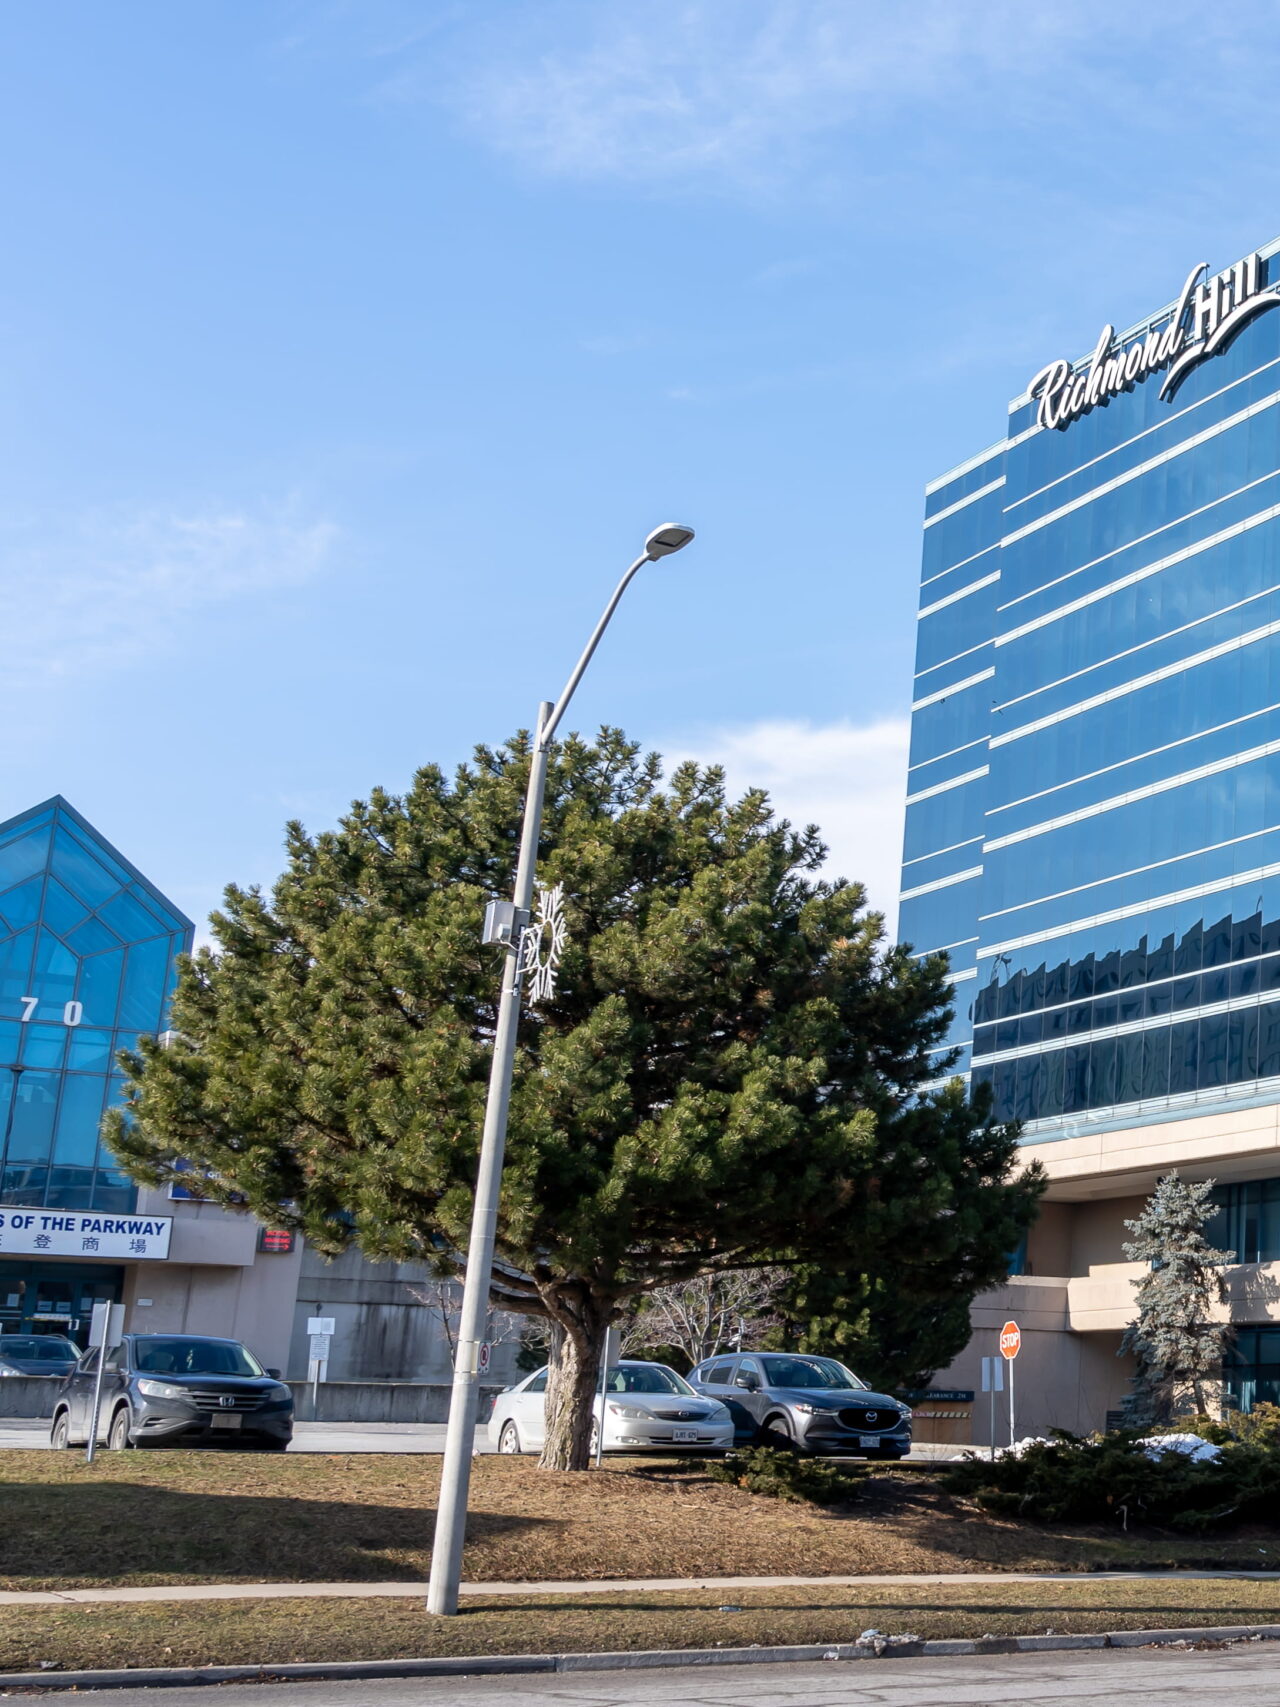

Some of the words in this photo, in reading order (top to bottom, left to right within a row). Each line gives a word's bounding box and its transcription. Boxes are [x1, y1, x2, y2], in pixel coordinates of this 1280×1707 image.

[1027, 262, 1210, 430] Richmond
[1194, 252, 1262, 341] Hill
[11, 1215, 35, 1230] OF
[41, 1217, 76, 1231] THE
[81, 1219, 165, 1236] PARKWAY
[1002, 1332, 1019, 1349] STOP
